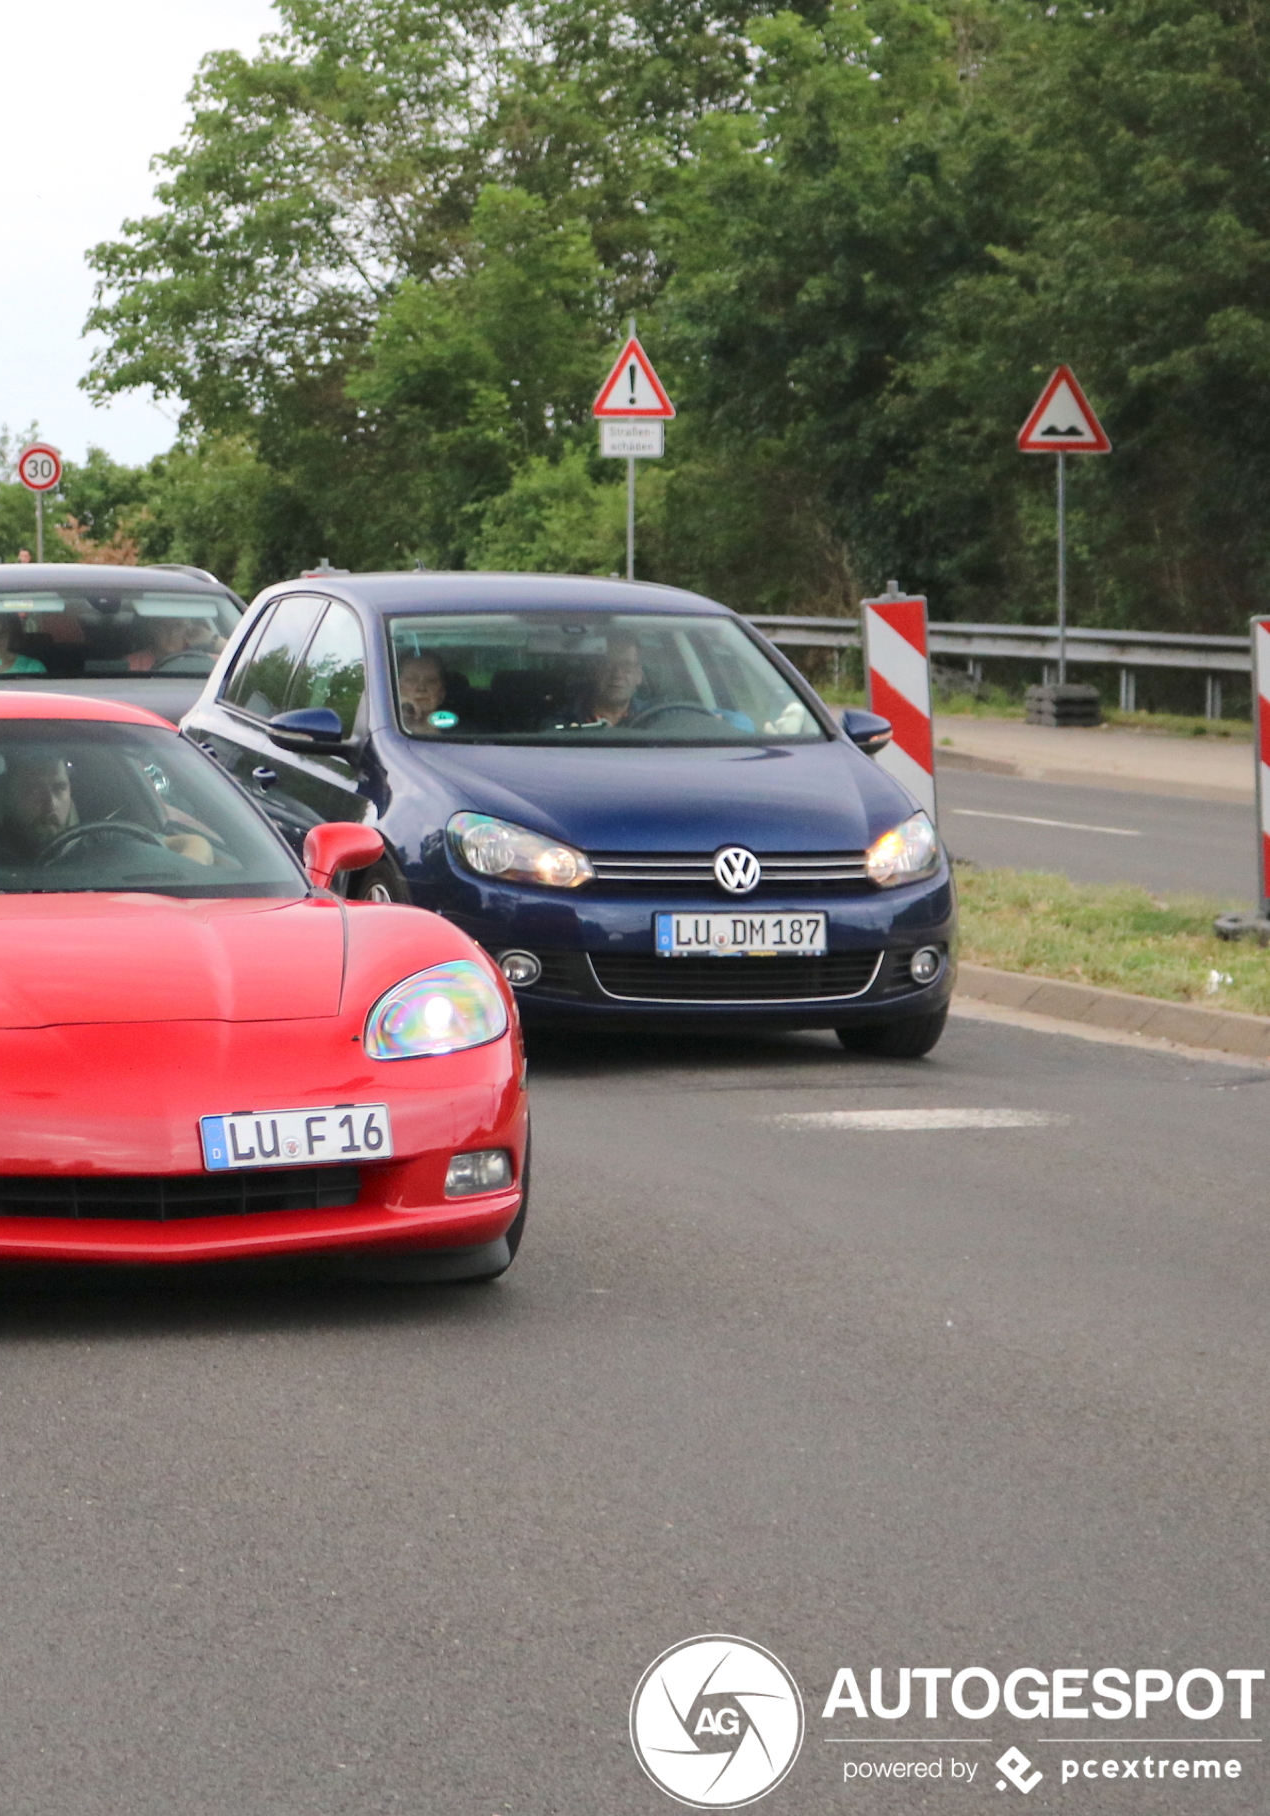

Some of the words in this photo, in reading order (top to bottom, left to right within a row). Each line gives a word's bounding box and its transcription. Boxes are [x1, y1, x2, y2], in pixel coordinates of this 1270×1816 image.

[28, 459, 52, 479] 30
[676, 919, 711, 945] LU
[731, 919, 766, 945] DM
[772, 919, 821, 945] 187
[228, 1119, 280, 1161] LU
[305, 1116, 327, 1155] F
[338, 1113, 384, 1153] 16
[212, 1148, 222, 1160] D
